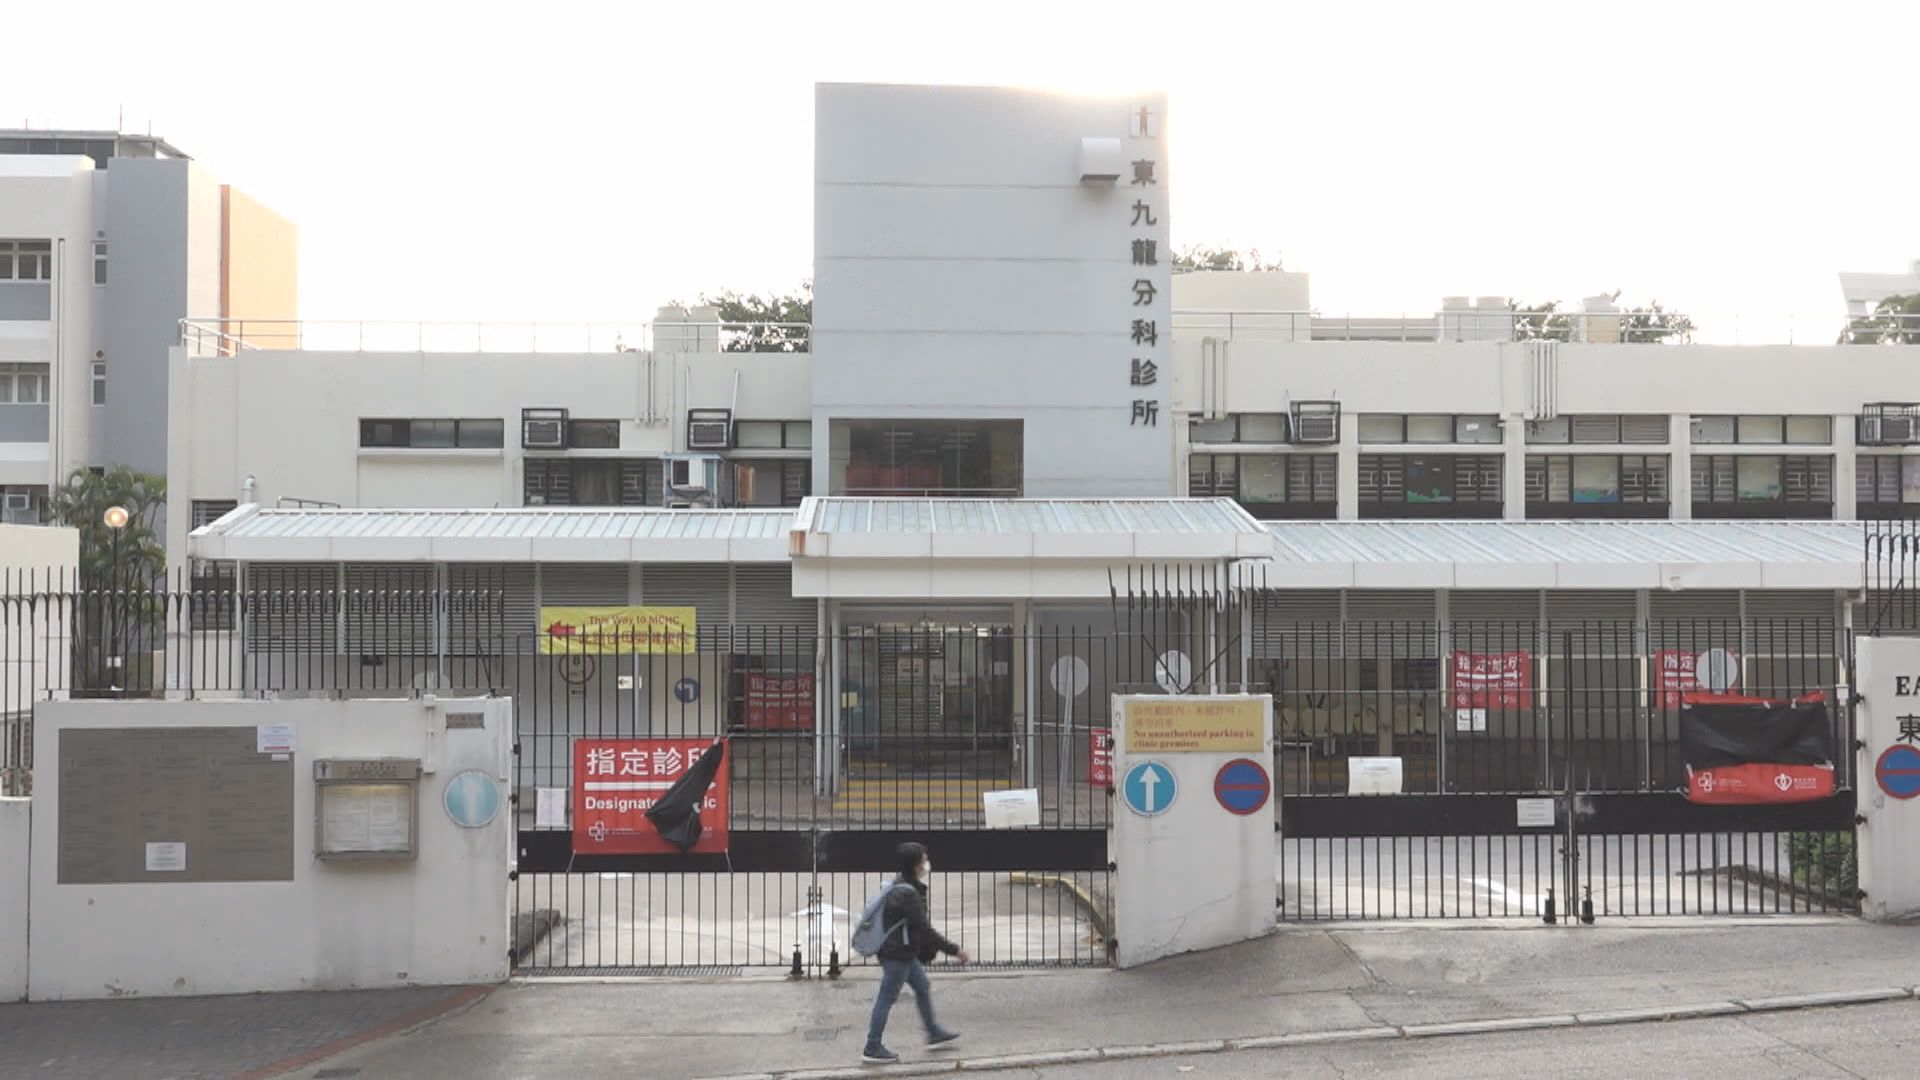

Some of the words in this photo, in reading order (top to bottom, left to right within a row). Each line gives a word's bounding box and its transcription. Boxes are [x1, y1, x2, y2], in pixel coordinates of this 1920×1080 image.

[1131, 159, 1158, 427] 東九龍分科診所
[637, 616, 647, 624] to
[1209, 729, 1244, 740] parking
[1246, 729, 1254, 737] in
[1896, 713, 1920, 743] 東
[1134, 740, 1158, 748] clinic
[1160, 740, 1199, 749] premises
[585, 796, 657, 813] Designat
